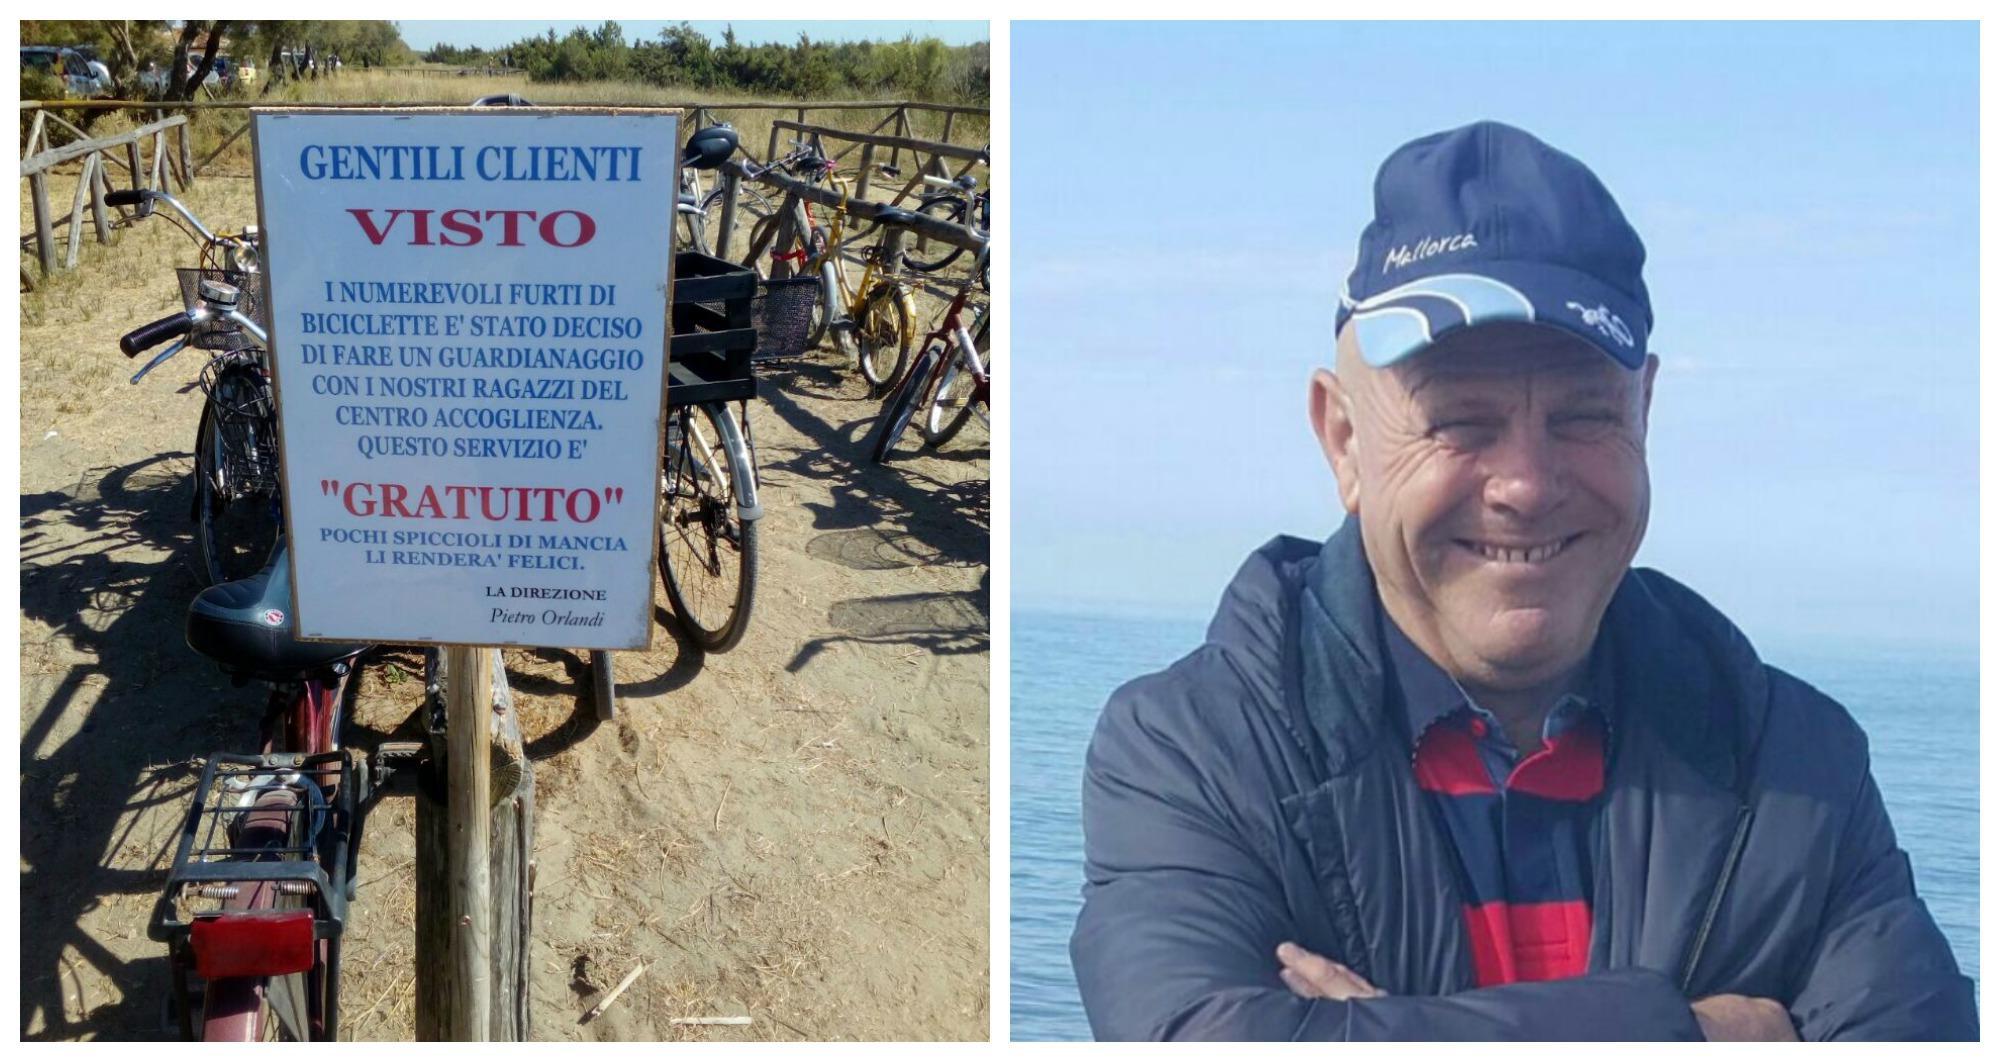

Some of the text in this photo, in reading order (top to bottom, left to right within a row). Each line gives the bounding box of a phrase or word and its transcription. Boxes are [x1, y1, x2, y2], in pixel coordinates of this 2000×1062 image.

[300, 145, 642, 181] GENTILI CLIENTI
[346, 209, 596, 248] VISTO
[1382, 232, 1478, 274] Mallorca
[325, 281, 615, 306] I NUMEREVOLI FURTI DI
[302, 313, 642, 339] BICICLETTE E' STATO DECISO
[302, 345, 643, 370] DI FARE UN GUARDIANAGGIO
[313, 375, 628, 400] CON I NOSTRI RAGAZZI DEL
[336, 406, 603, 430] CENTRO ACCOGLIENZA.
[358, 436, 587, 460] QUESTO SERVIZIO E'
[321, 480, 624, 523] "GRATUITO"
[320, 528, 627, 551] POCHI SPICCIOLI DI MANCIA
[366, 550, 585, 571] LI RENDERA' FELICI.
[486, 586, 607, 601] LA DIREZIONE
[490, 608, 605, 627] Pietro Orlandi
